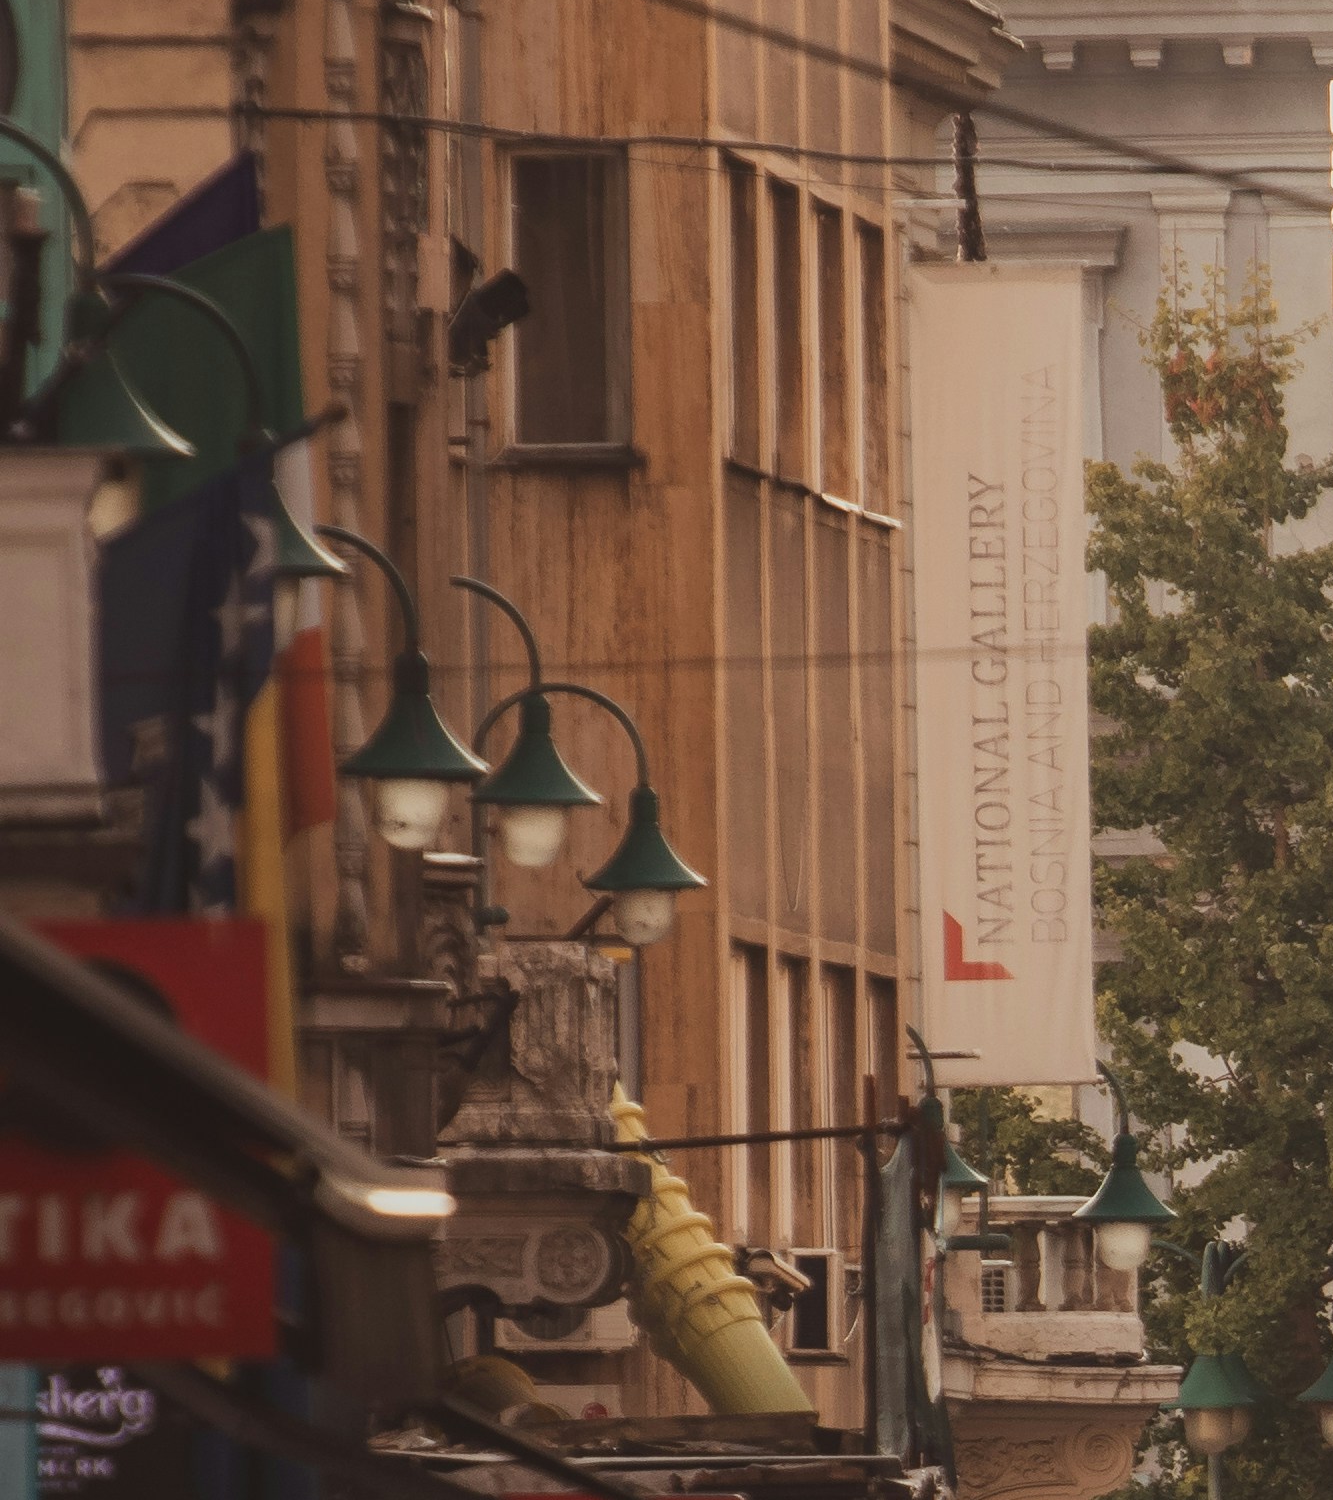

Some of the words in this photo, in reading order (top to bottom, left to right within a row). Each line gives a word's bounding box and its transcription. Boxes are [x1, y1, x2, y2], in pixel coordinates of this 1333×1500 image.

[968, 472, 1008, 686] GALLERY
[1021, 363, 1060, 663] HERZEGOVINA
[972, 701, 1014, 946] NATIONAL
[1025, 680, 1063, 772] AND
[1028, 785, 1068, 943] BOSNIA
